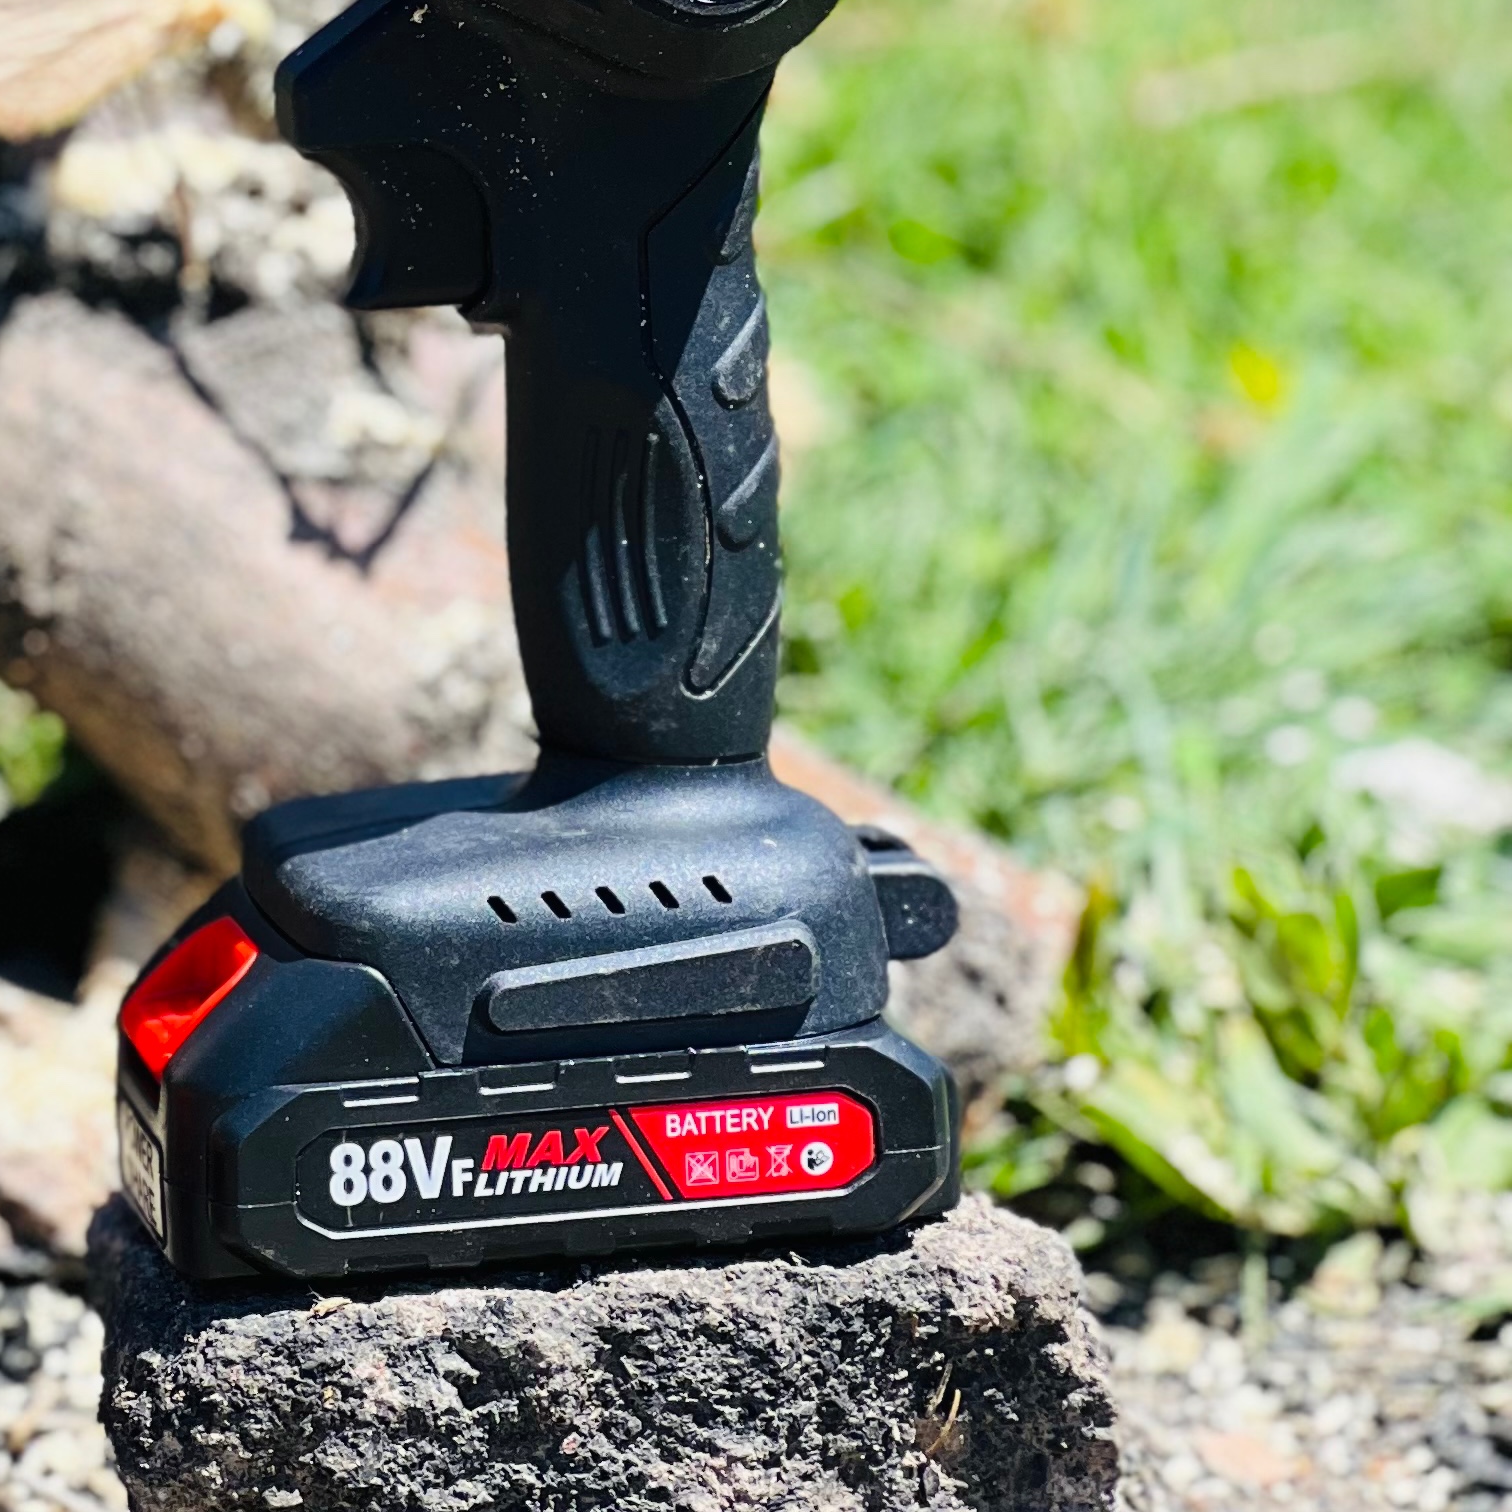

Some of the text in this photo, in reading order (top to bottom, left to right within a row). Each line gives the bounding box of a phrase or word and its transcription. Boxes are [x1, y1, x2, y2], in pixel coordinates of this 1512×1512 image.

[665, 1106, 774, 1138] BATTERY
[481, 1126, 610, 1171] MAX
[474, 1162, 623, 1197] LITHIUM
